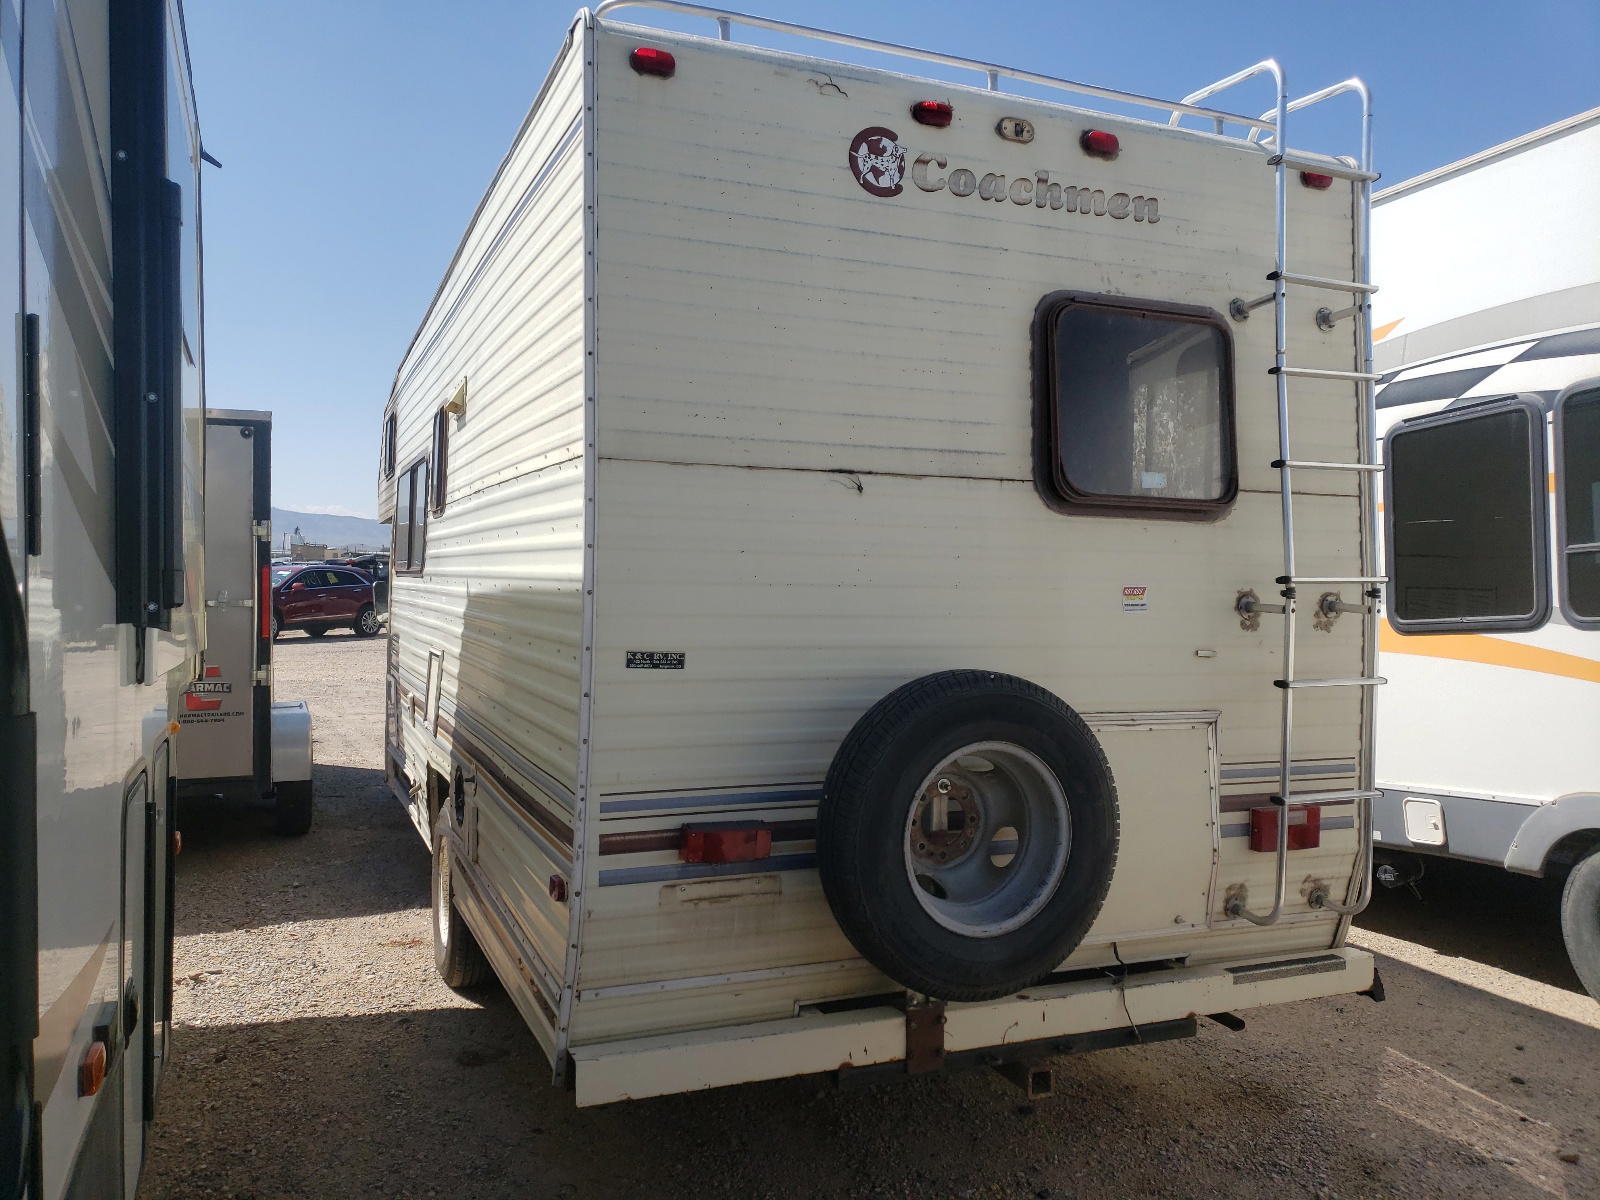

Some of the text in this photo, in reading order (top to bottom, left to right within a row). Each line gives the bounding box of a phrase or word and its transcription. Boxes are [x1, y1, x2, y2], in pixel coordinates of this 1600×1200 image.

[911, 151, 1160, 224] Coachmen
[627, 652, 634, 660] K
[635, 652, 643, 660] &
[644, 652, 651, 660] C
[190, 683, 231, 692] ARMAC
